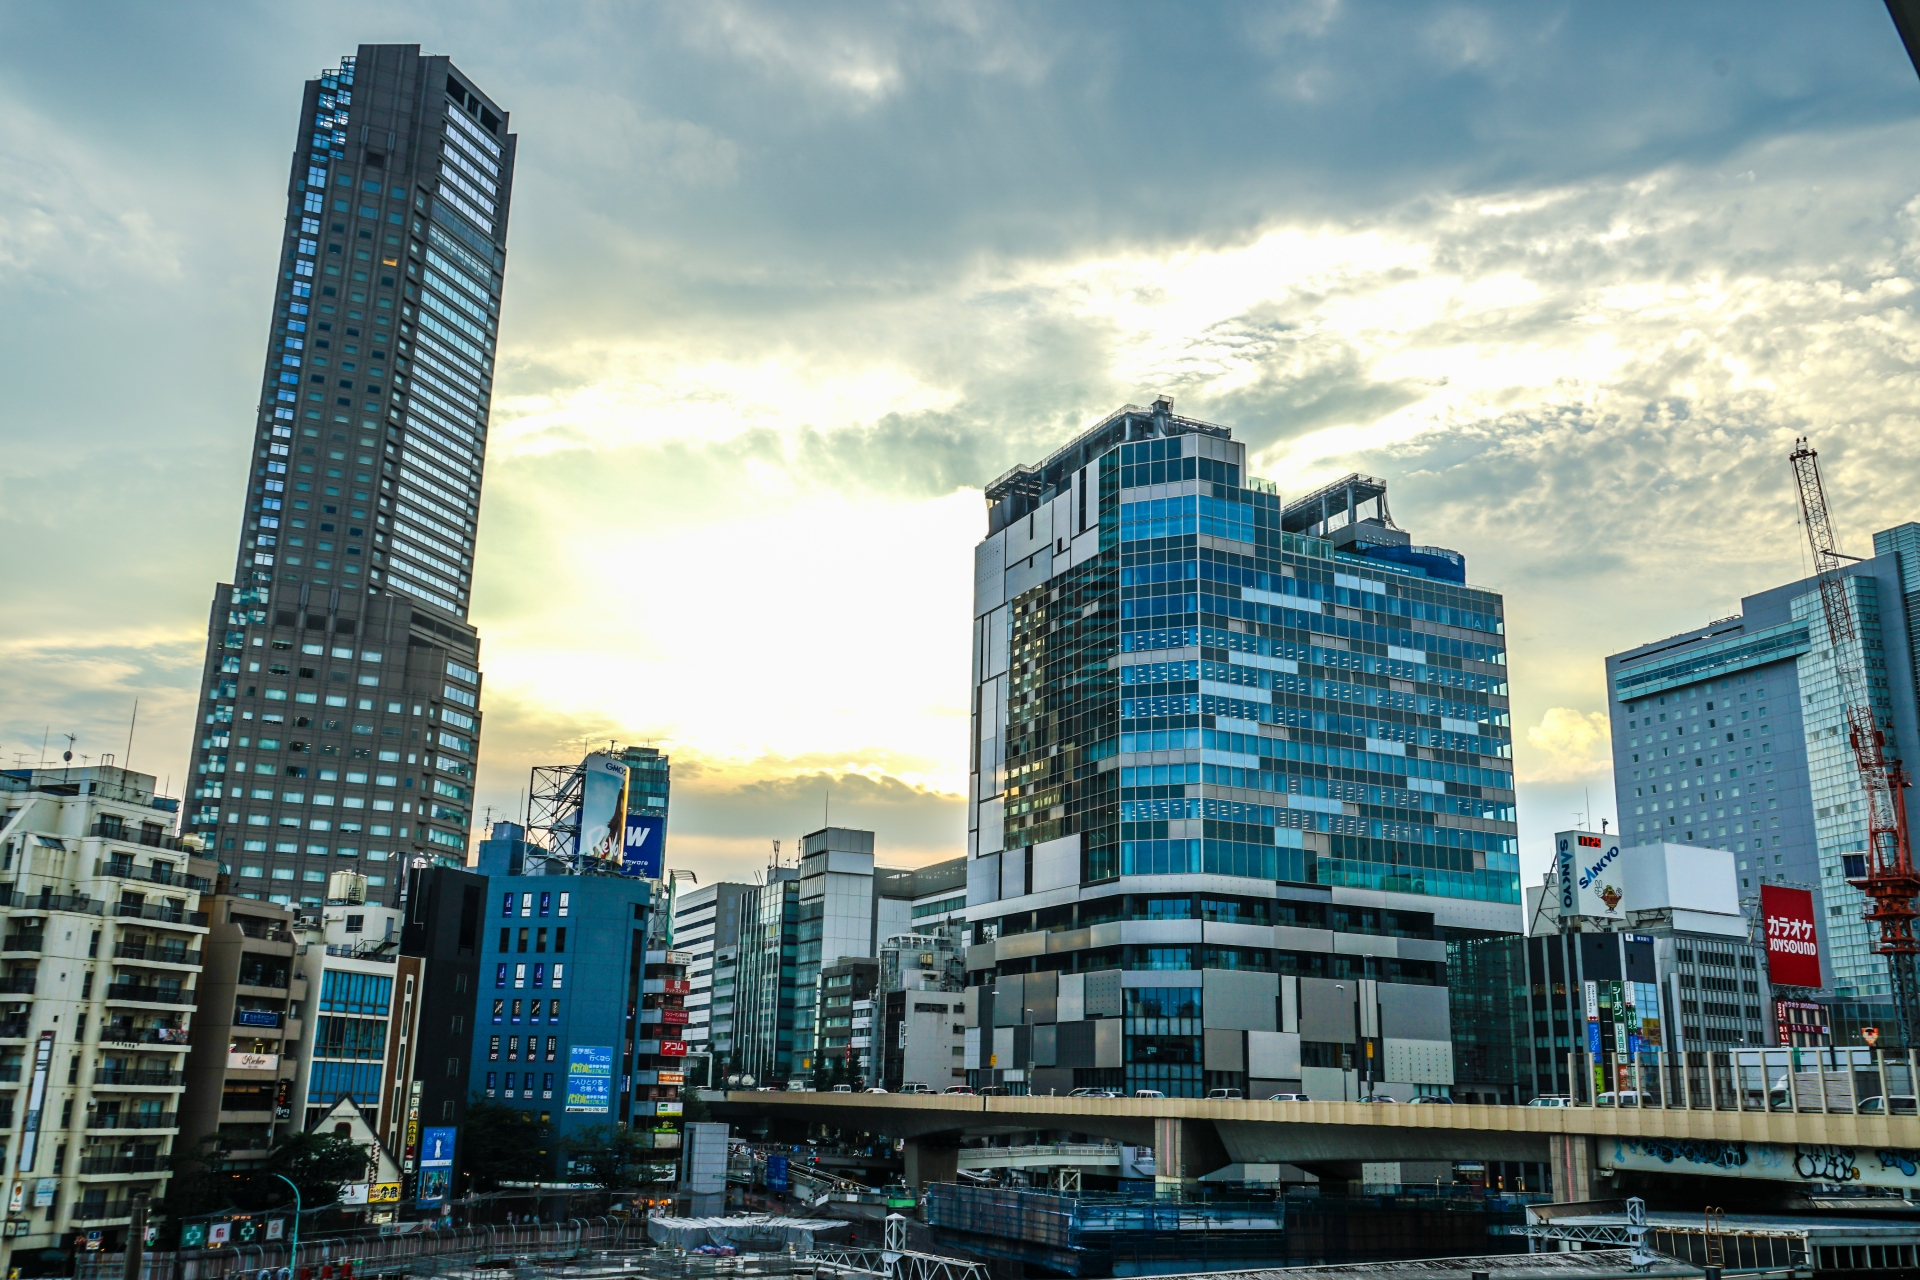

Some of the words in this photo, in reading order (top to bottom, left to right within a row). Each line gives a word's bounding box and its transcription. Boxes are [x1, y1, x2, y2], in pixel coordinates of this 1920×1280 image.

[1560, 838, 1574, 909] SANKYO
[1579, 846, 1619, 889] SANKYO
[1767, 915, 1813, 940] カラオケ
[1769, 937, 1817, 956] JOYSOUND
[663, 1041, 684, 1051] アコム
